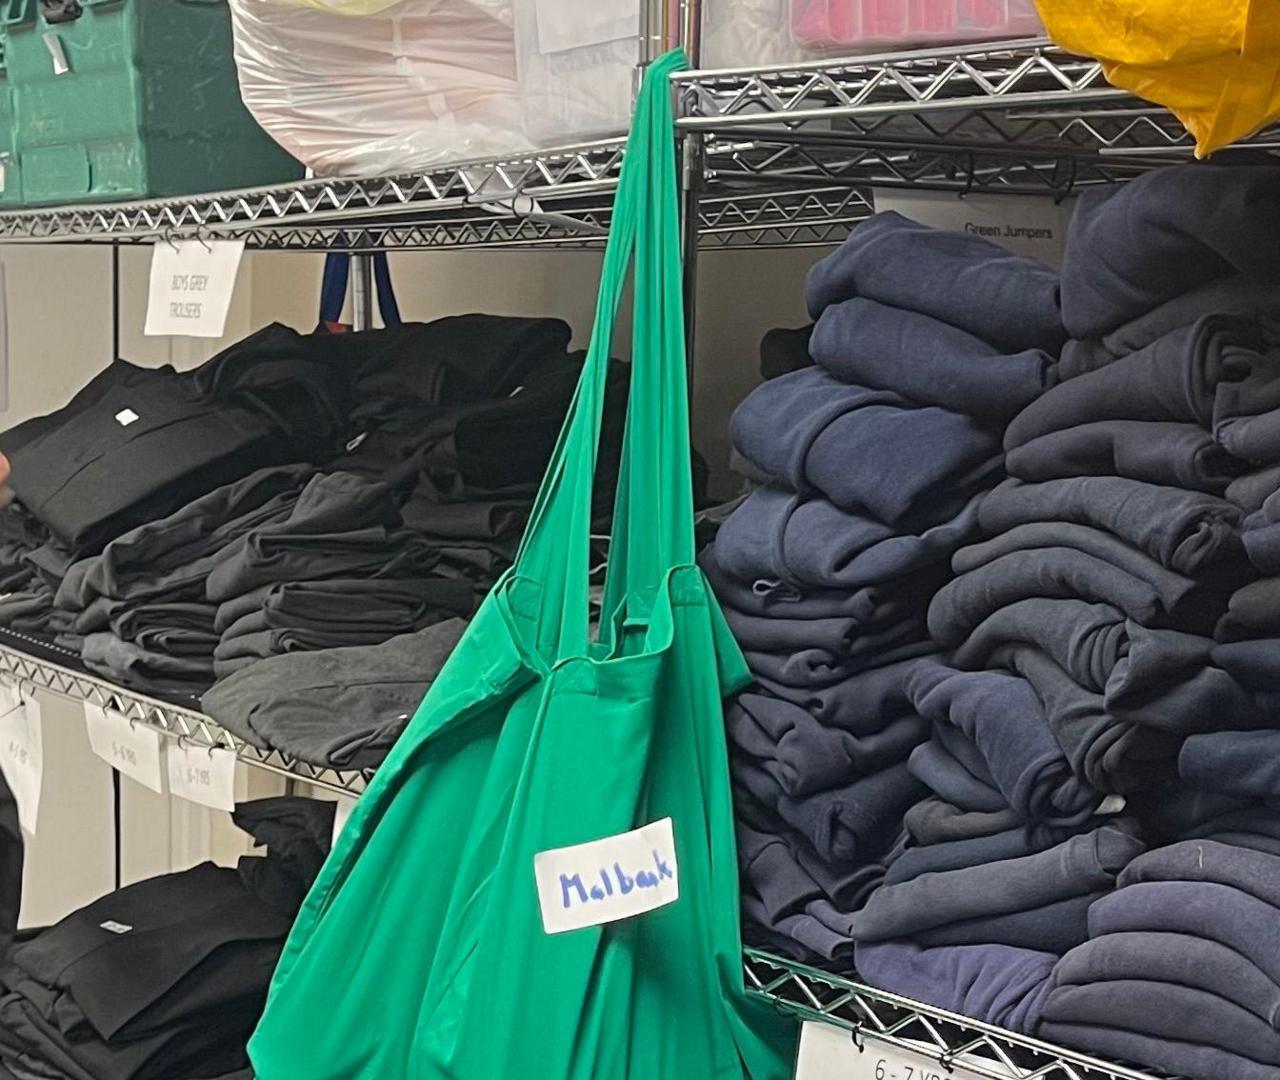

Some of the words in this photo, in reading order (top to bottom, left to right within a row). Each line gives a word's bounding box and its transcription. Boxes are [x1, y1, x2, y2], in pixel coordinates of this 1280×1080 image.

[964, 222, 1001, 237] Green
[1004, 223, 1053, 239] Jumpers
[874, 1059, 885, 1080] 6
